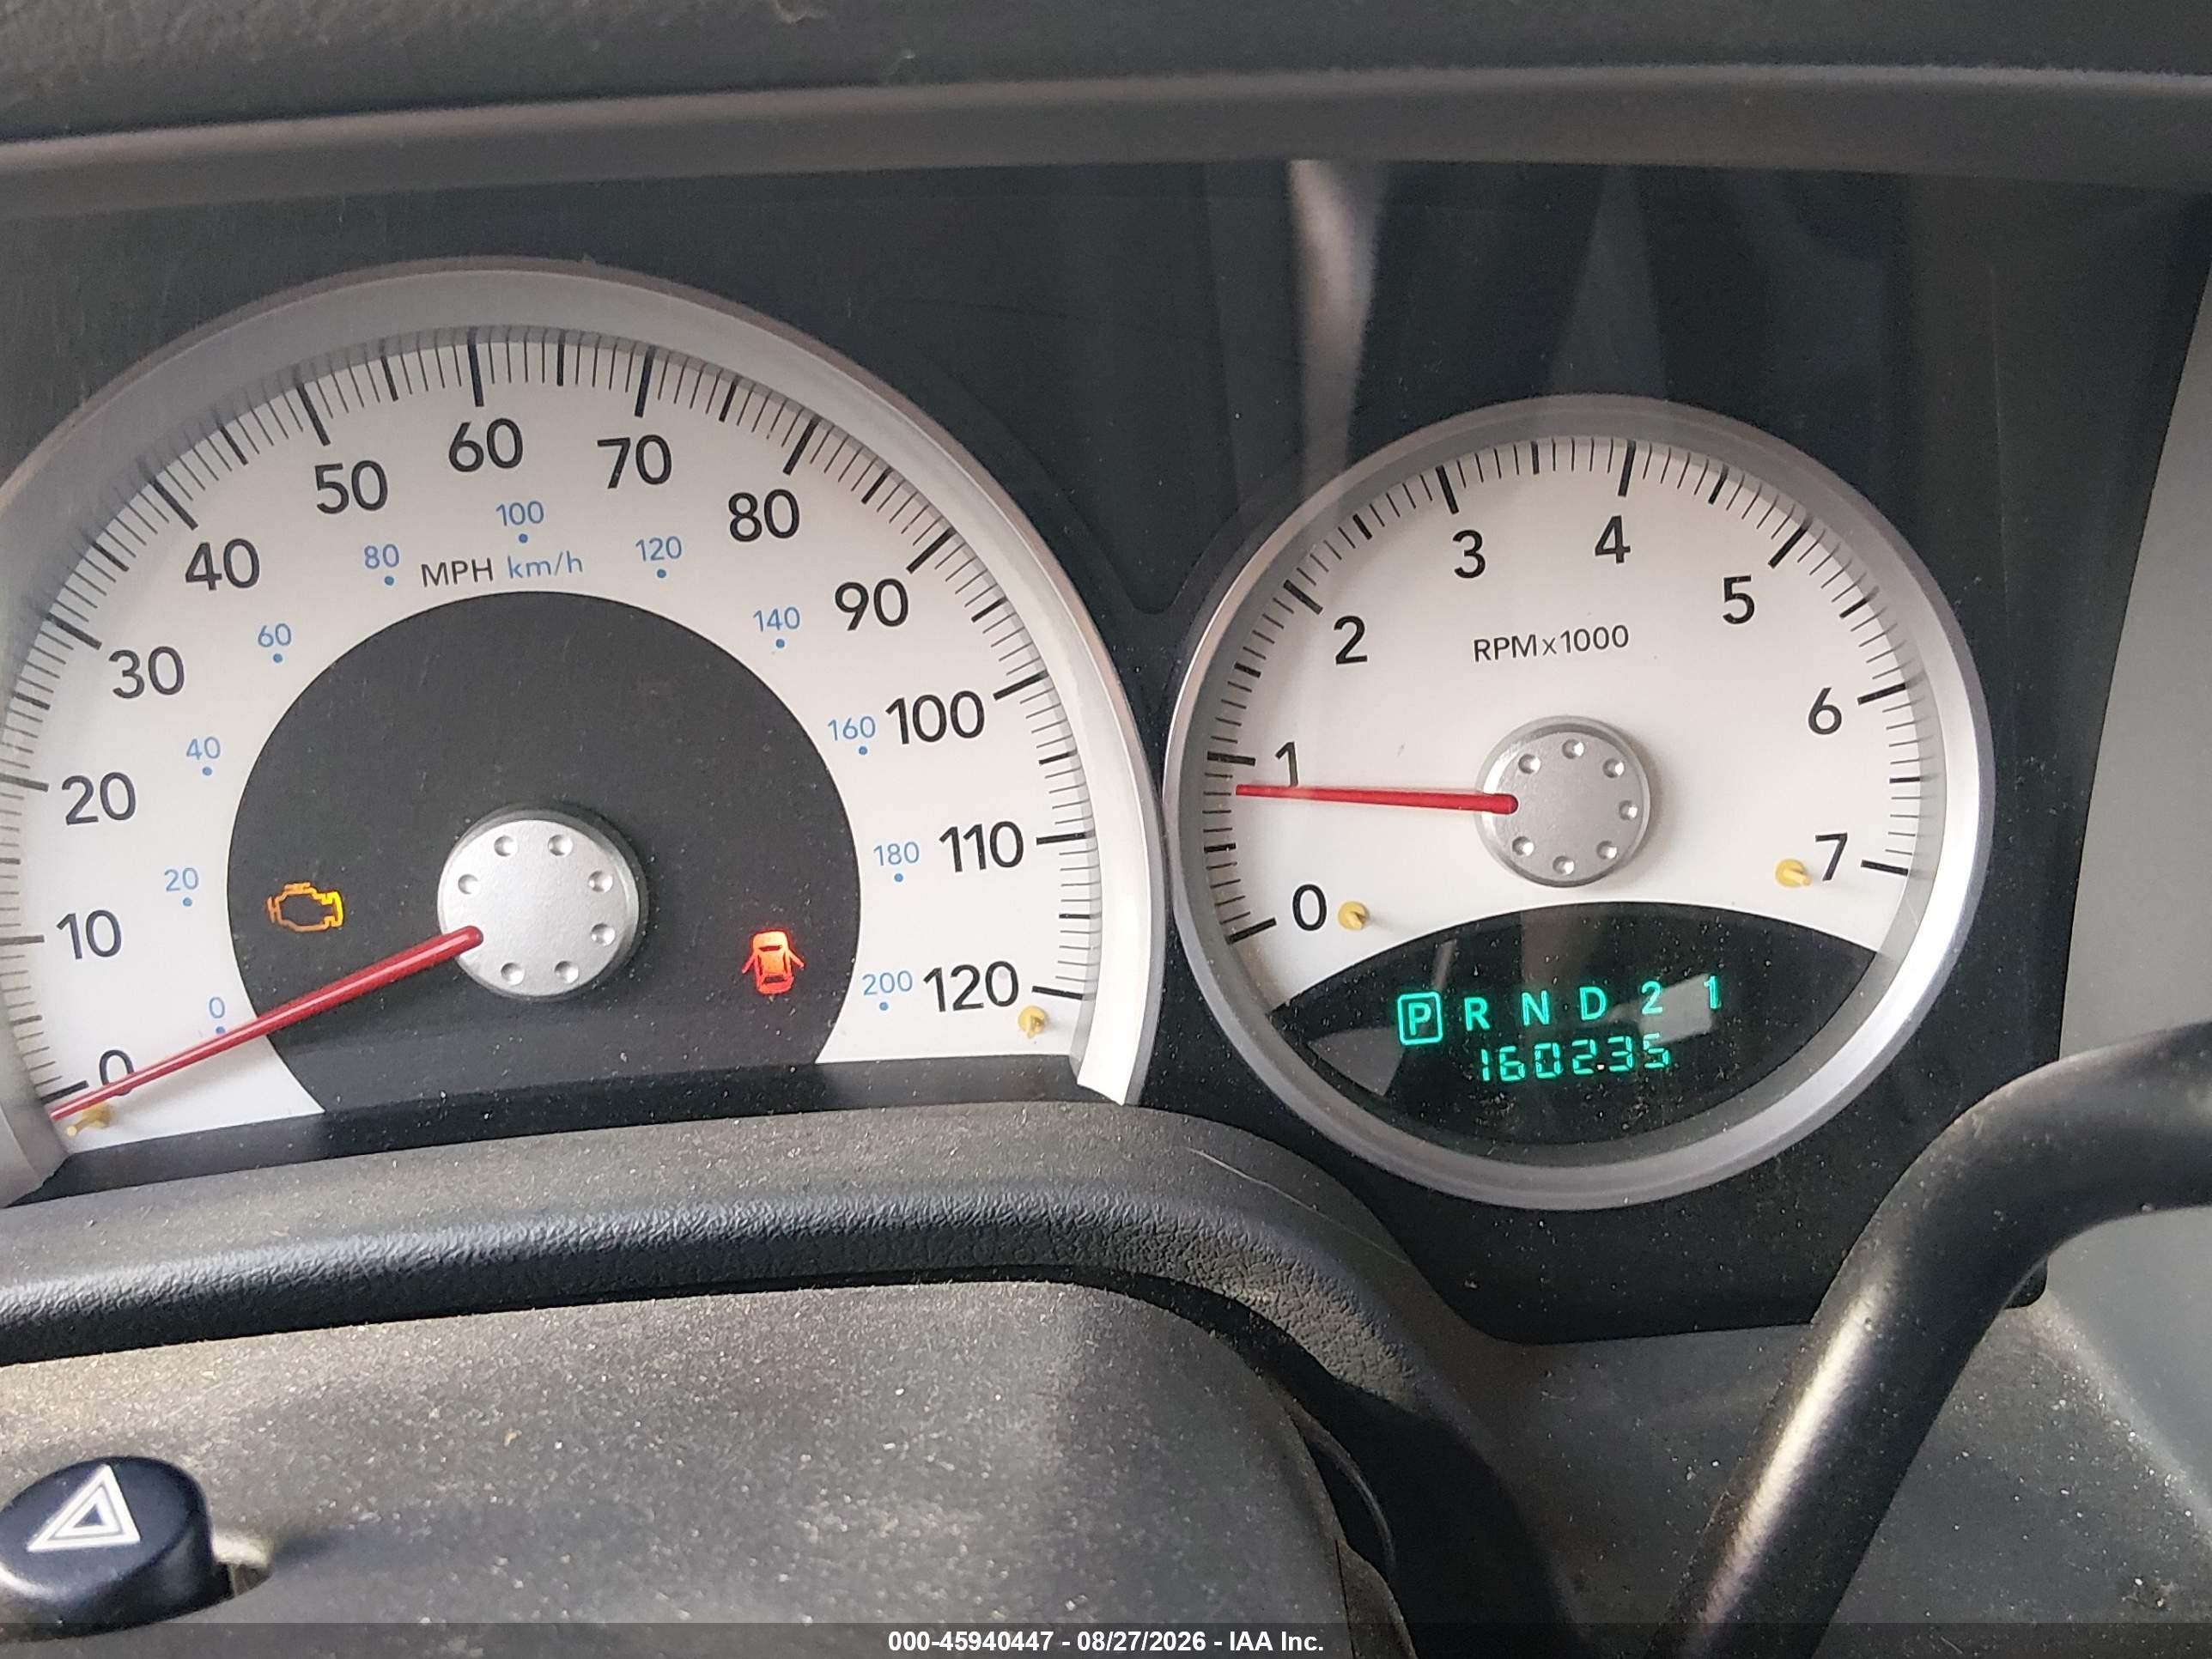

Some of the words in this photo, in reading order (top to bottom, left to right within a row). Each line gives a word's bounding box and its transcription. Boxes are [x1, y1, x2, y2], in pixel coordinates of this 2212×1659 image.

[448, 418, 524, 472] 60
[597, 434, 673, 489] 70
[313, 459, 389, 514] 50
[495, 501, 545, 526] 100
[727, 489, 800, 543] 80
[363, 544, 400, 569] 80
[635, 535, 683, 562] 120
[1453, 529, 1486, 579] 3
[1594, 514, 1632, 564] 4
[185, 538, 260, 591] 40
[421, 558, 494, 587] MPH
[507, 551, 583, 580] km/h
[752, 606, 801, 633] 140
[835, 578, 909, 632] 90
[1722, 574, 1756, 626] 5
[258, 623, 293, 648] 60
[1334, 614, 1369, 665] 2
[108, 646, 185, 700] 30
[827, 715, 877, 741] 160
[884, 690, 986, 745] 100
[1807, 687, 1843, 735] 6
[185, 736, 222, 761] 40
[1274, 741, 1299, 787] 1
[61, 772, 137, 826] 20
[872, 842, 921, 866] 180
[939, 820, 1024, 873] 110
[1814, 832, 1850, 883] 7
[164, 866, 199, 892] 20
[1291, 883, 1328, 932] 0
[56, 909, 122, 960] 10
[208, 996, 227, 1020] 0
[861, 970, 914, 996] 200
[922, 961, 1020, 1013] 120
[1407, 1004, 1433, 1034] P
[1464, 996, 1490, 1030] R
[1522, 990, 1549, 1026] N
[1579, 986, 1607, 1021] D
[1641, 981, 1664, 1016] 2
[1704, 975, 1720, 1010] 1
[98, 1048, 136, 1097] 0
[1480, 1033, 1670, 1083] 160235
